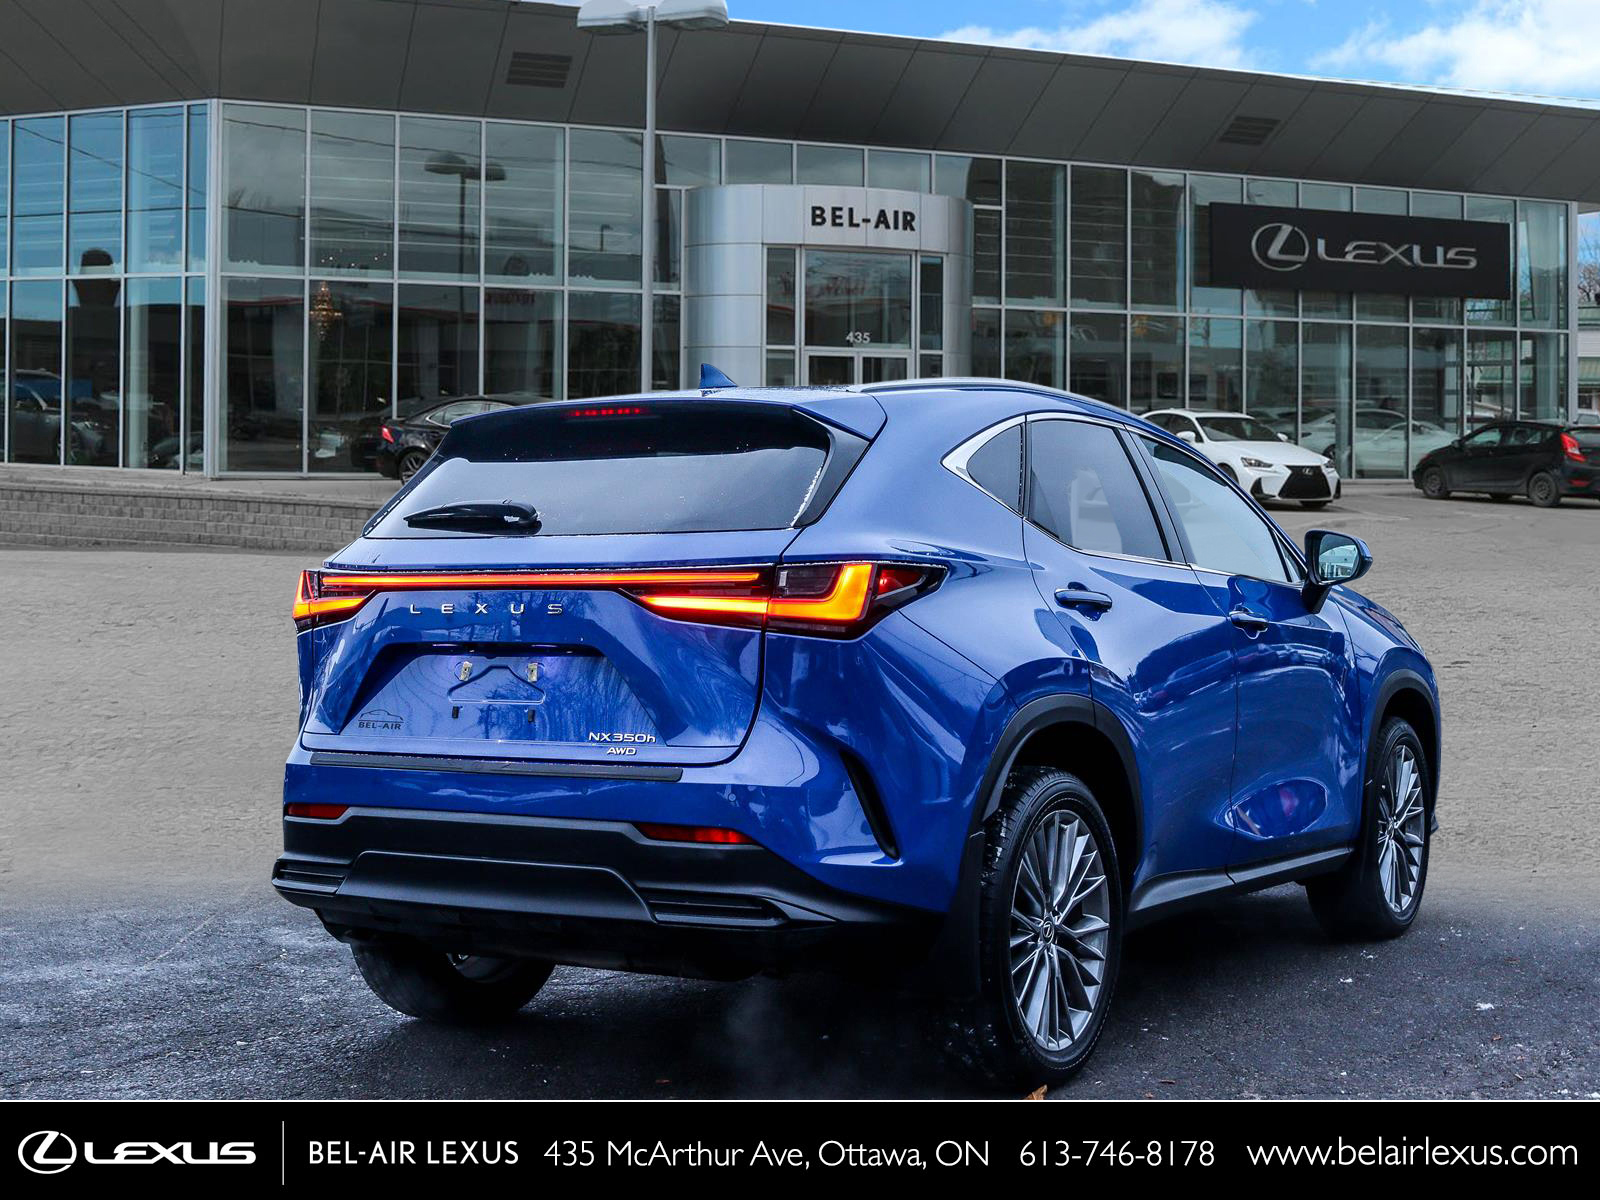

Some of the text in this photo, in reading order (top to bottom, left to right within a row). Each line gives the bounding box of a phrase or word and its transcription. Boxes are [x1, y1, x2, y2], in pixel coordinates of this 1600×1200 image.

[811, 206, 916, 232] BEL-AIR
[1317, 237, 1478, 269] LEXUS
[845, 331, 871, 344] 435
[409, 603, 564, 615] LEXUS
[358, 721, 402, 730] BEL-AIR
[588, 732, 656, 743] NX350h
[606, 746, 637, 756] AWD
